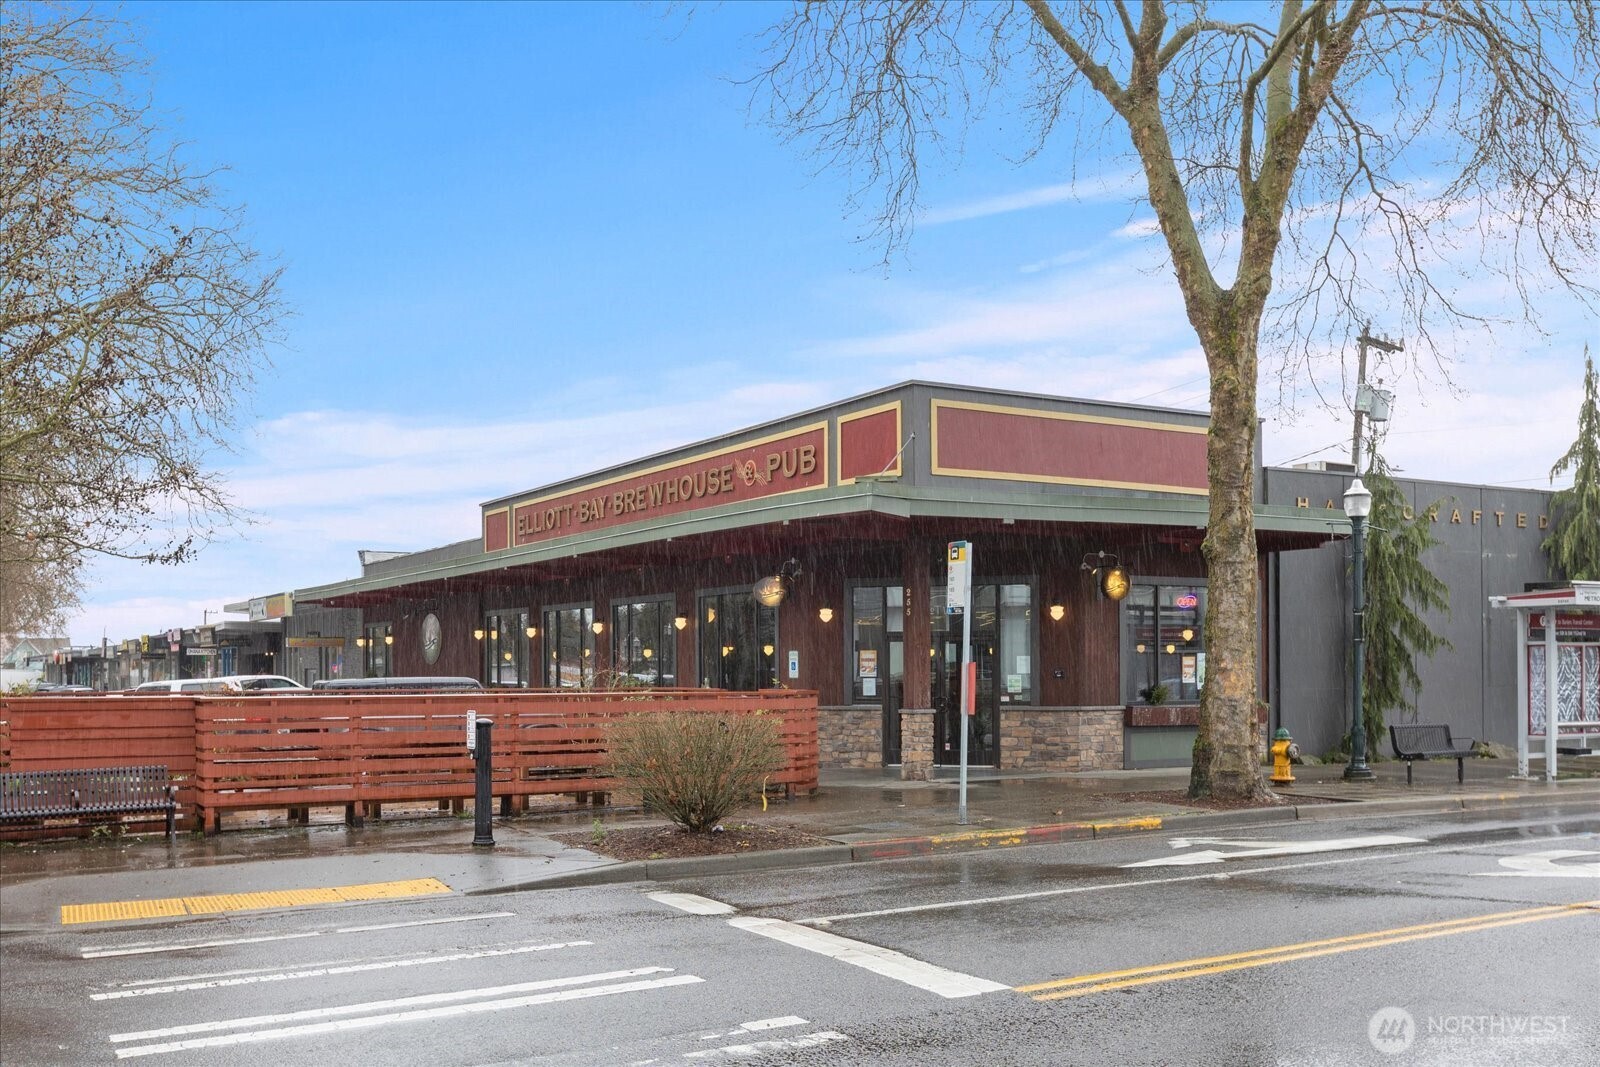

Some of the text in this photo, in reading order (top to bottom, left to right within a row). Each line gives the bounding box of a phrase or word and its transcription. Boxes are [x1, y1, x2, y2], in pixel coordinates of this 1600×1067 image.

[518, 503, 573, 537] ELLIOTT
[577, 494, 609, 523] BAY
[612, 464, 736, 515] BREWHOUSE
[766, 444, 817, 482] PUB
[1176, 597, 1196, 608] OPEN
